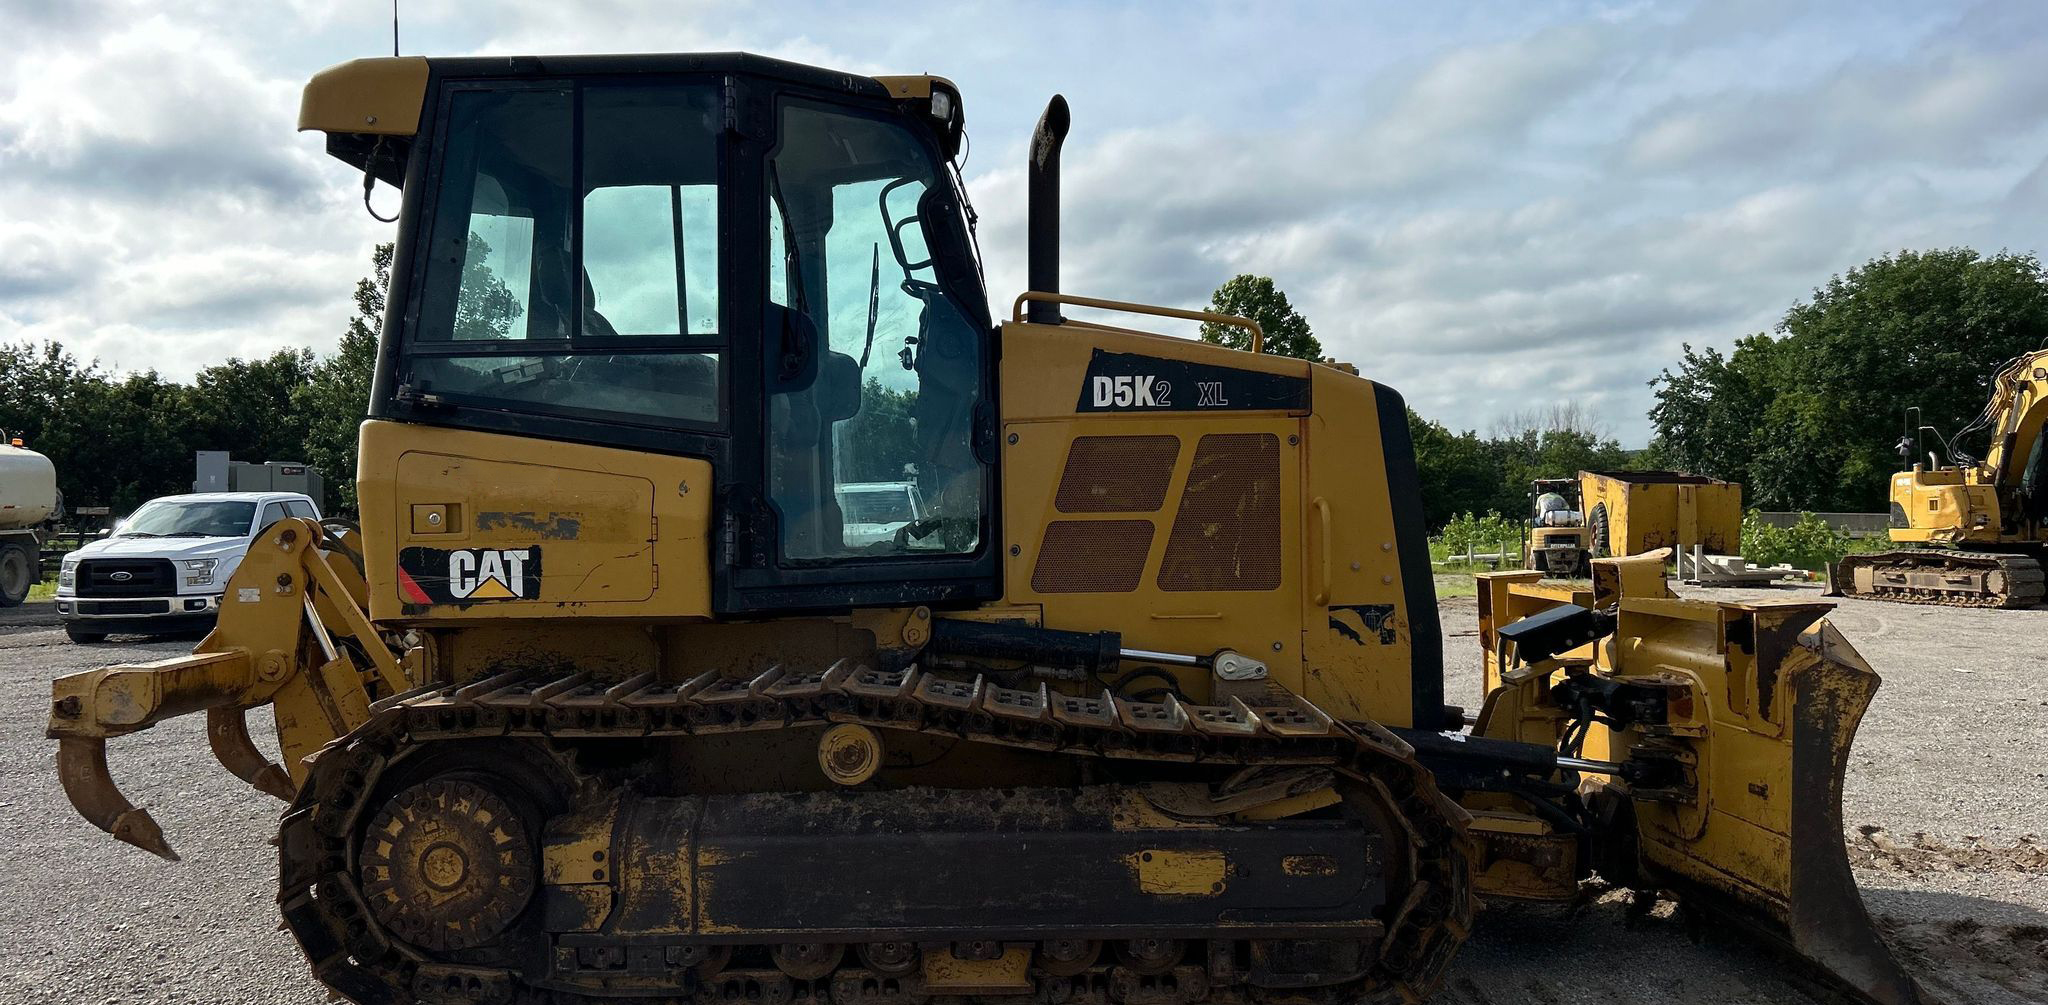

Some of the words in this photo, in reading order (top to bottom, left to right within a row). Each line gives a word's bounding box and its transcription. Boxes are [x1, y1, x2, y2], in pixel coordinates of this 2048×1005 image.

[1093, 375, 1172, 407] D5K2
[1197, 382, 1229, 406] XL
[450, 550, 530, 599] CAT
